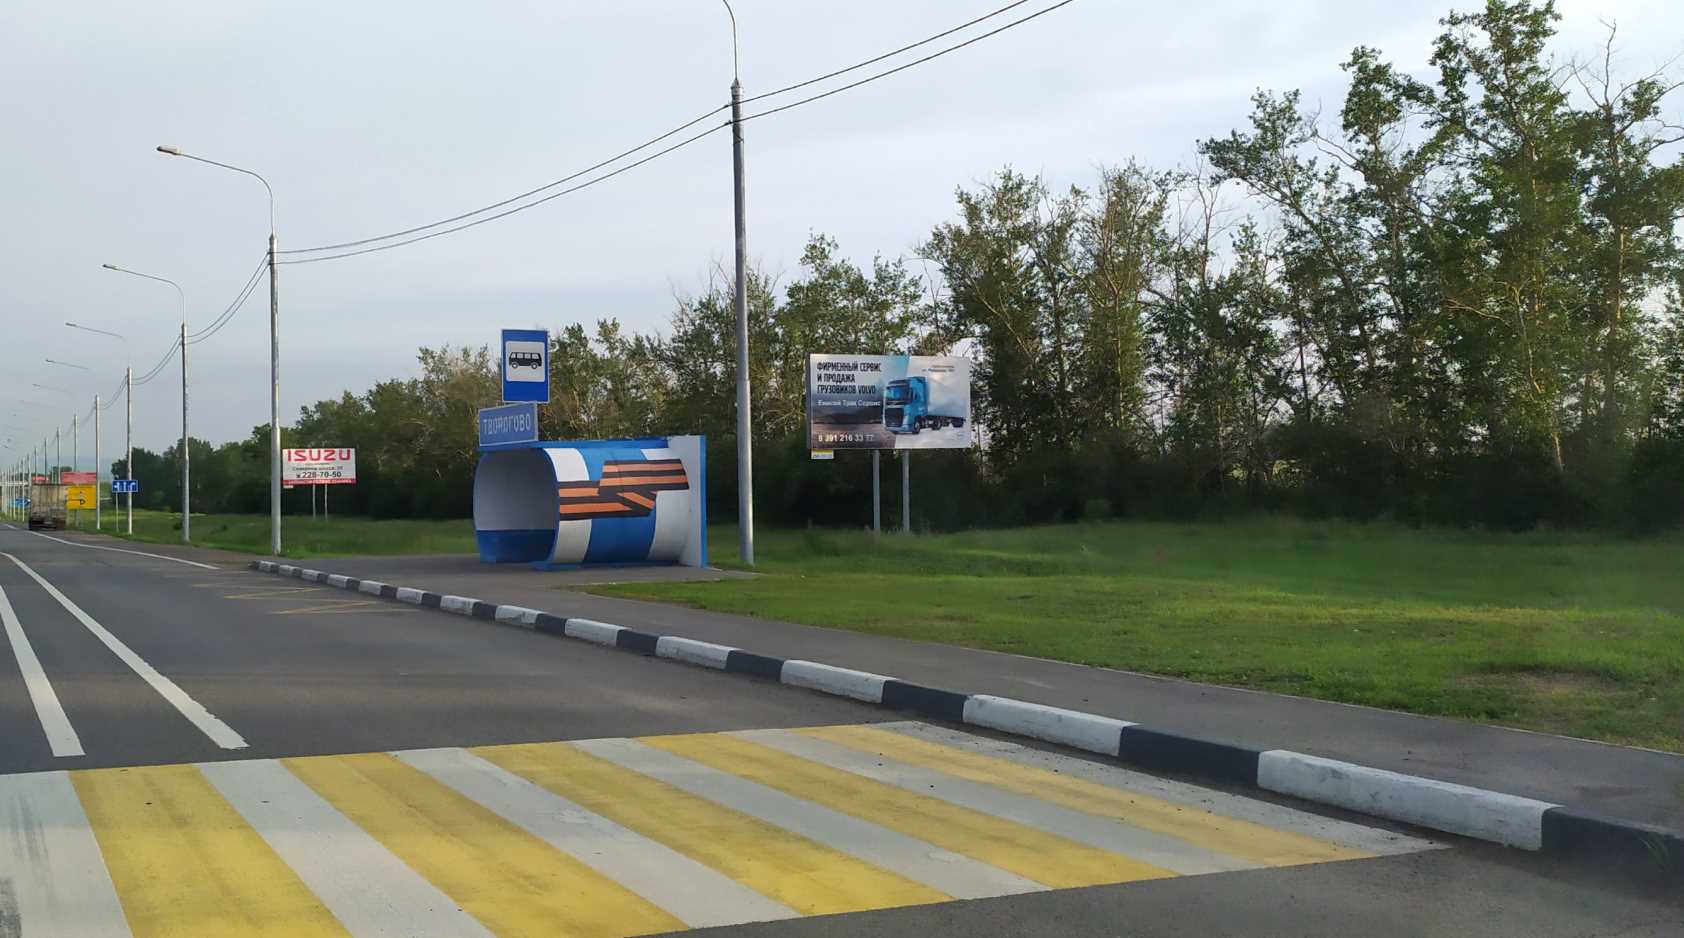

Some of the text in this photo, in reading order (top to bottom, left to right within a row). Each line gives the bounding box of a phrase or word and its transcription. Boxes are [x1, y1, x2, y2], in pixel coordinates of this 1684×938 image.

[817, 361, 882, 372] ФИРМЕННЫЙ СЕРВИС
[817, 374, 855, 384] И ПРОДАЖА
[817, 385, 876, 394] ГРУЗОВИКОВ VOLVO
[288, 449, 351, 461] ISUZU
